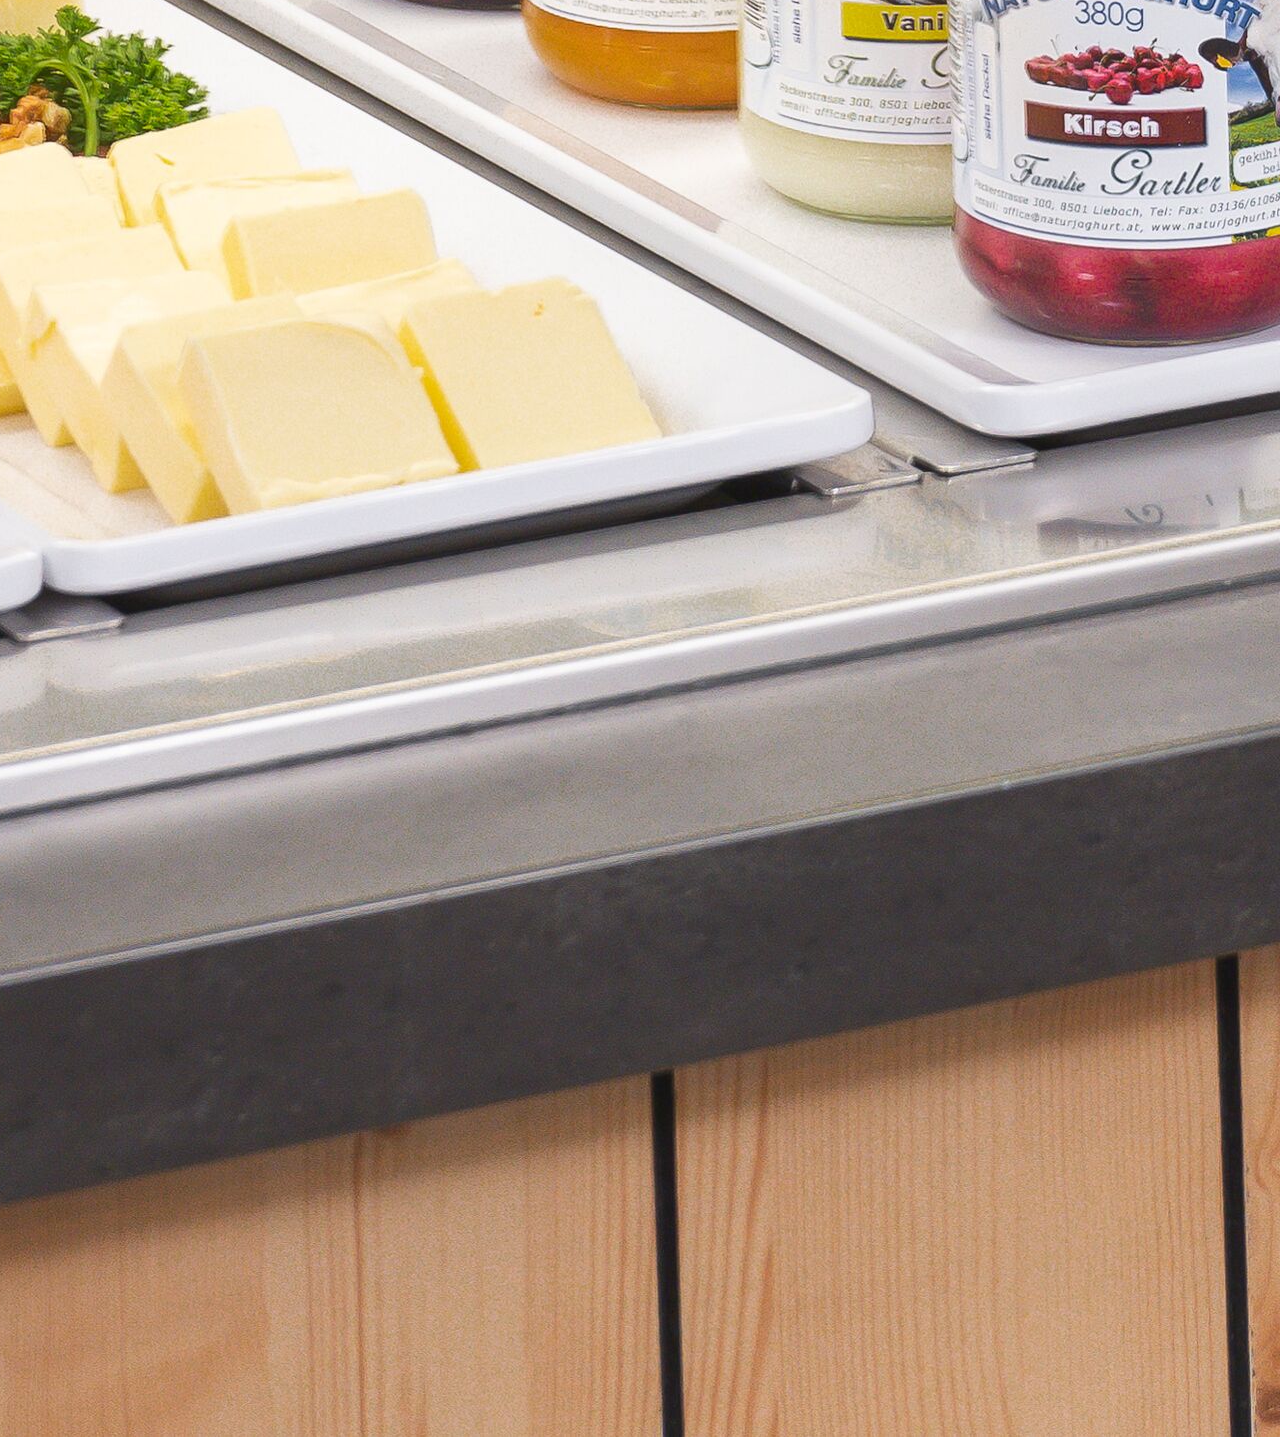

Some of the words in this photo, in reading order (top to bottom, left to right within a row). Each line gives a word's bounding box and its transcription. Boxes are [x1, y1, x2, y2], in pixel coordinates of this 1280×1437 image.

[1074, 0, 1145, 32] 380g
[1063, 113, 1160, 138] Kirsch
[1009, 153, 1087, 192] Familie
[1100, 149, 1222, 196] Gartler
[1059, 201, 1088, 214] 8501
[1092, 205, 1144, 218] Lieboch,
[1149, 205, 1173, 218] Tel:
[1177, 205, 1205, 216] Fax:
